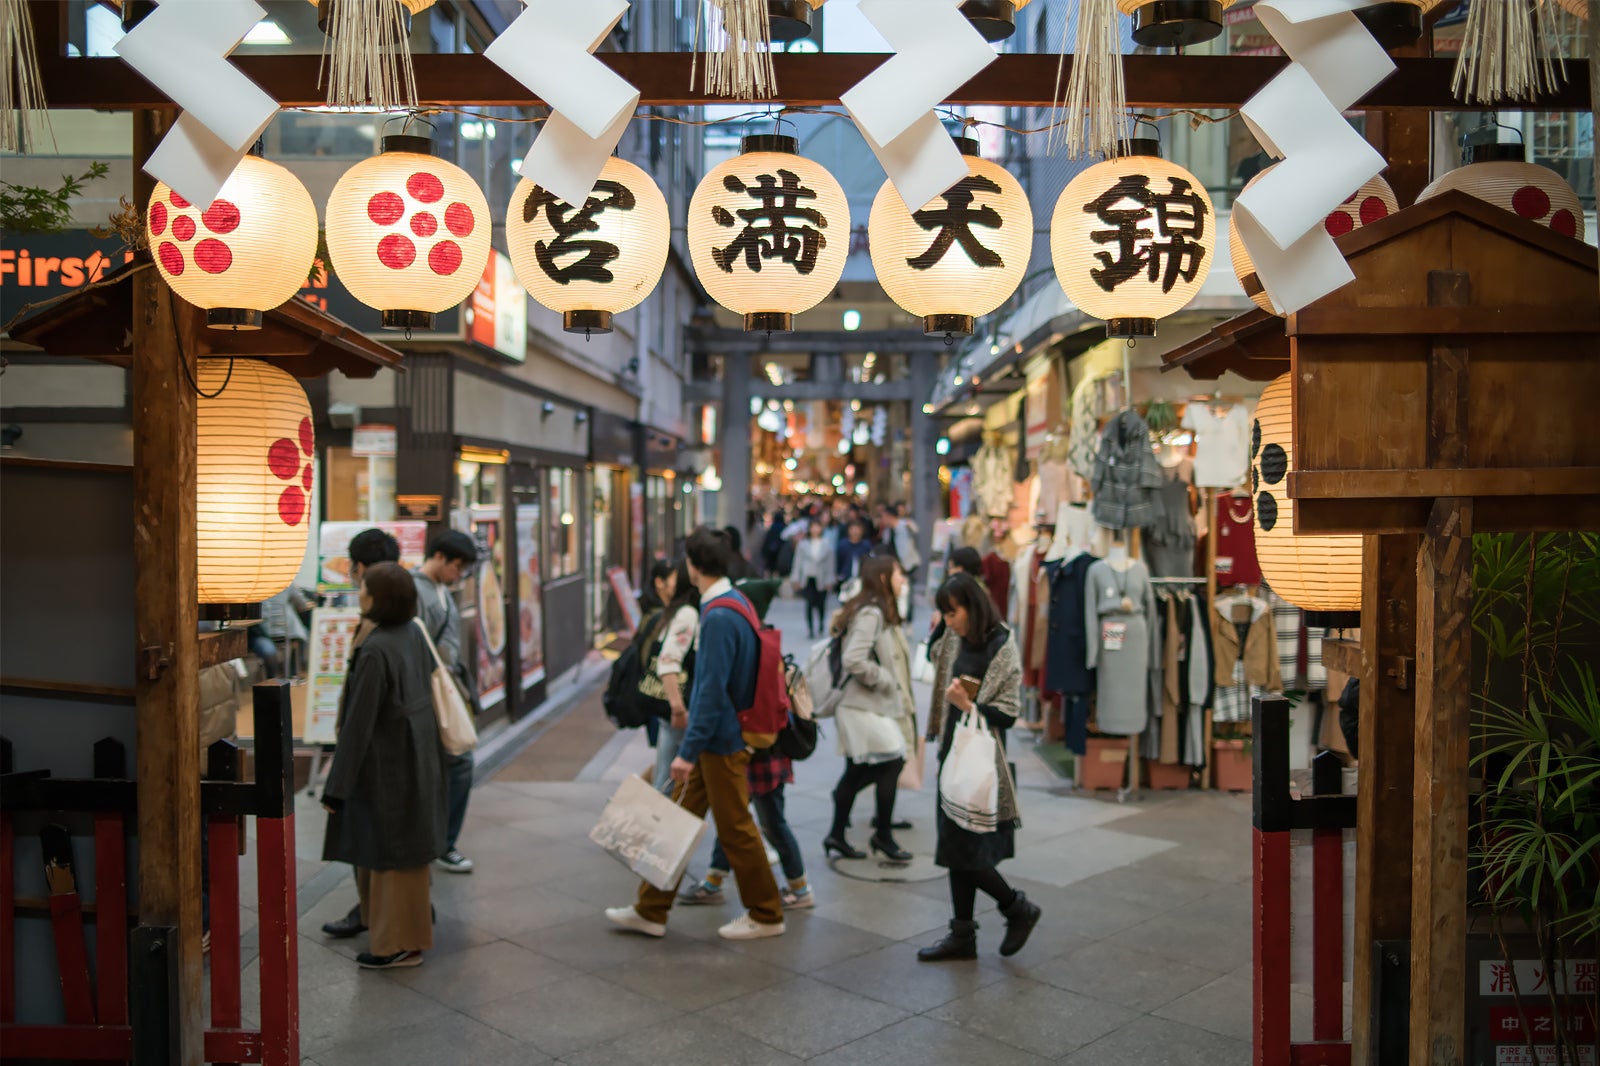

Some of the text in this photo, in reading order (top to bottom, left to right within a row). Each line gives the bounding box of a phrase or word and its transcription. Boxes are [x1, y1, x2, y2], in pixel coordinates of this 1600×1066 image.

[0, 248, 111, 287] First
[523, 179, 636, 285] 宮
[711, 168, 828, 274] 満
[905, 174, 1005, 270] 天
[1083, 174, 1209, 294] 錦
[1500, 1047, 1591, 1055] FIRE ETINGIER
